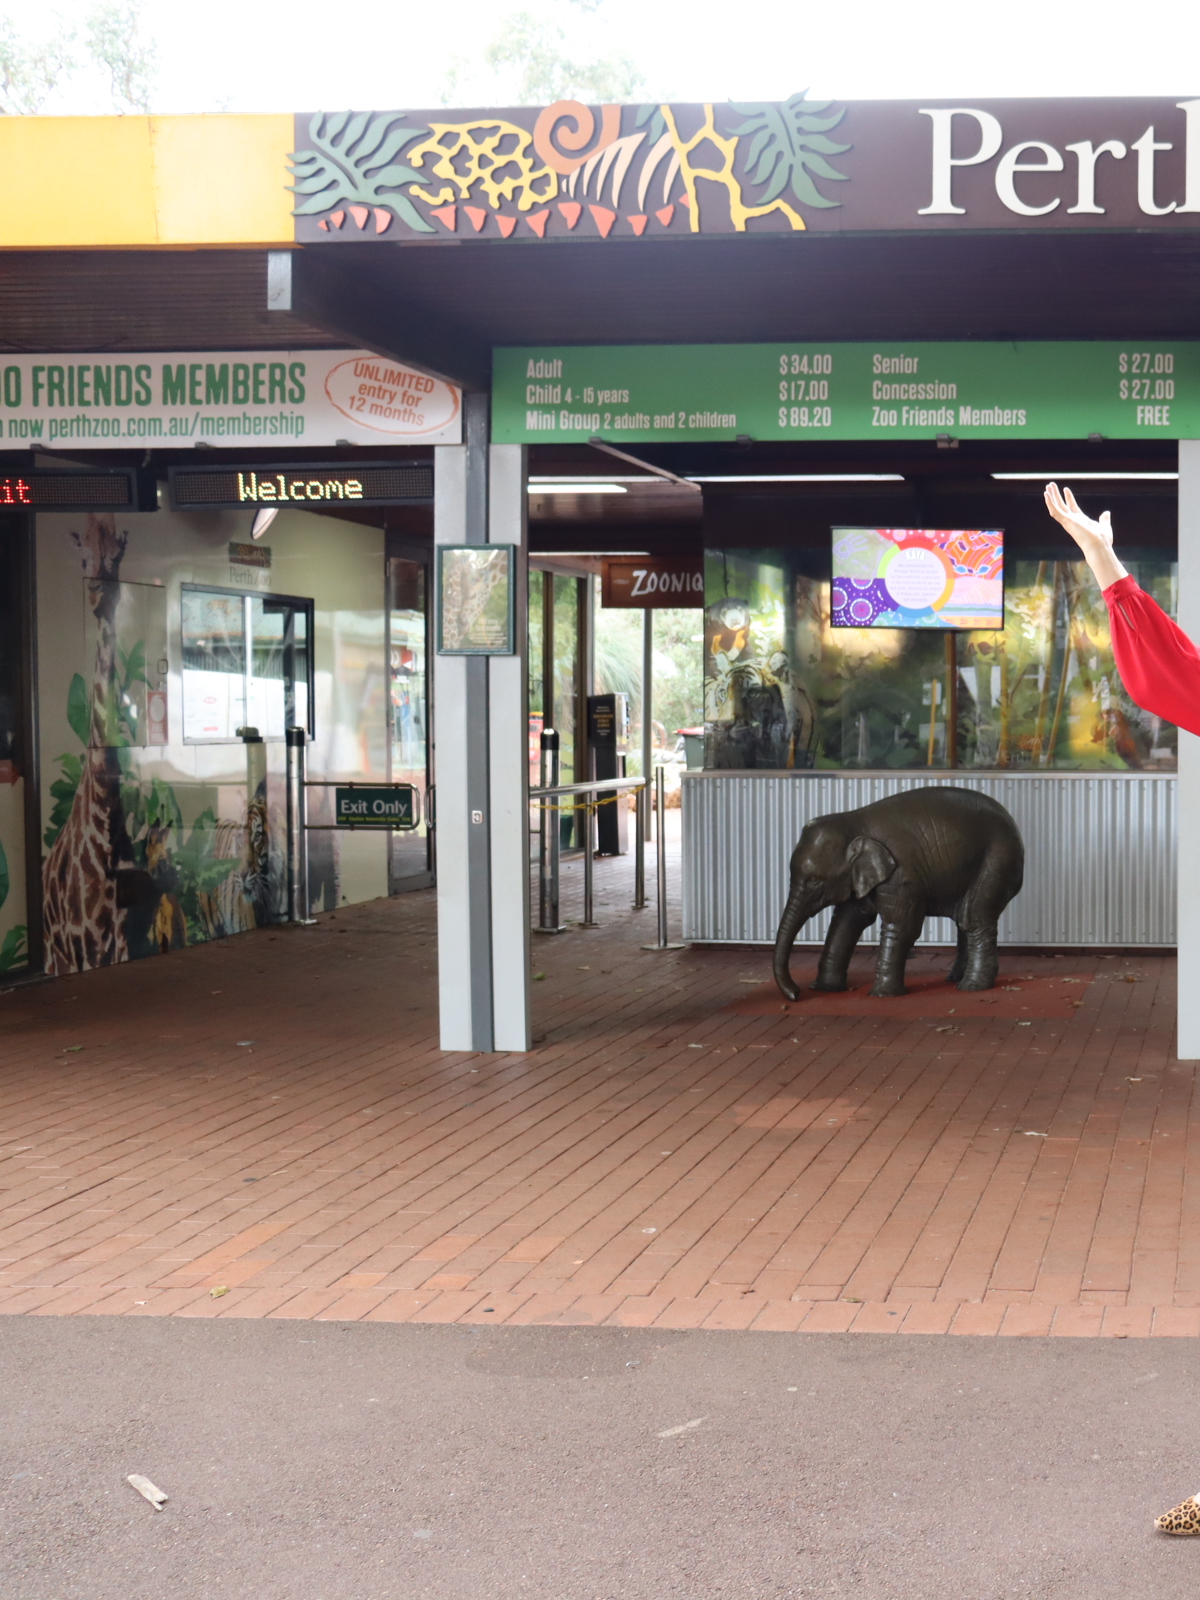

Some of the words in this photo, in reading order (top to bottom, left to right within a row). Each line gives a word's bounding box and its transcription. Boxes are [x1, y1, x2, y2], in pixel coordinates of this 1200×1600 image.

[526, 358, 563, 379] Adult
[873, 354, 919, 375] Senior
[0, 365, 22, 408] O
[32, 364, 152, 408] FRIENDS
[162, 362, 306, 406] MEMBERS
[353, 362, 435, 394] UNLIMITED
[872, 379, 957, 400] Concession
[358, 382, 397, 405] entry
[401, 390, 422, 408] for
[526, 384, 562, 405] Child
[565, 388, 573, 403] 4
[583, 387, 595, 404] 15
[597, 388, 629, 407] years
[349, 395, 364, 413] 12
[369, 402, 425, 426] months
[526, 410, 556, 431] Mini
[560, 410, 600, 432] Group
[603, 413, 611, 429] 2
[614, 412, 650, 430] adults
[653, 412, 675, 429] and
[678, 412, 686, 428] 2
[688, 411, 737, 429] children
[872, 406, 898, 427] Zoo
[902, 405, 955, 427] Friends
[959, 405, 1027, 426] Members
[1136, 405, 1170, 426] FREE
[8, 418, 44, 438] now
[49, 410, 305, 441] perthzoo.com.au/membership
[0, 479, 31, 503] it
[238, 472, 363, 502] Welcome
[905, 549, 926, 561] KAYA
[229, 565, 253, 585] Perth
[631, 569, 704, 597] ZOONIQ
[341, 799, 368, 814] Exit
[372, 799, 408, 817] Only
